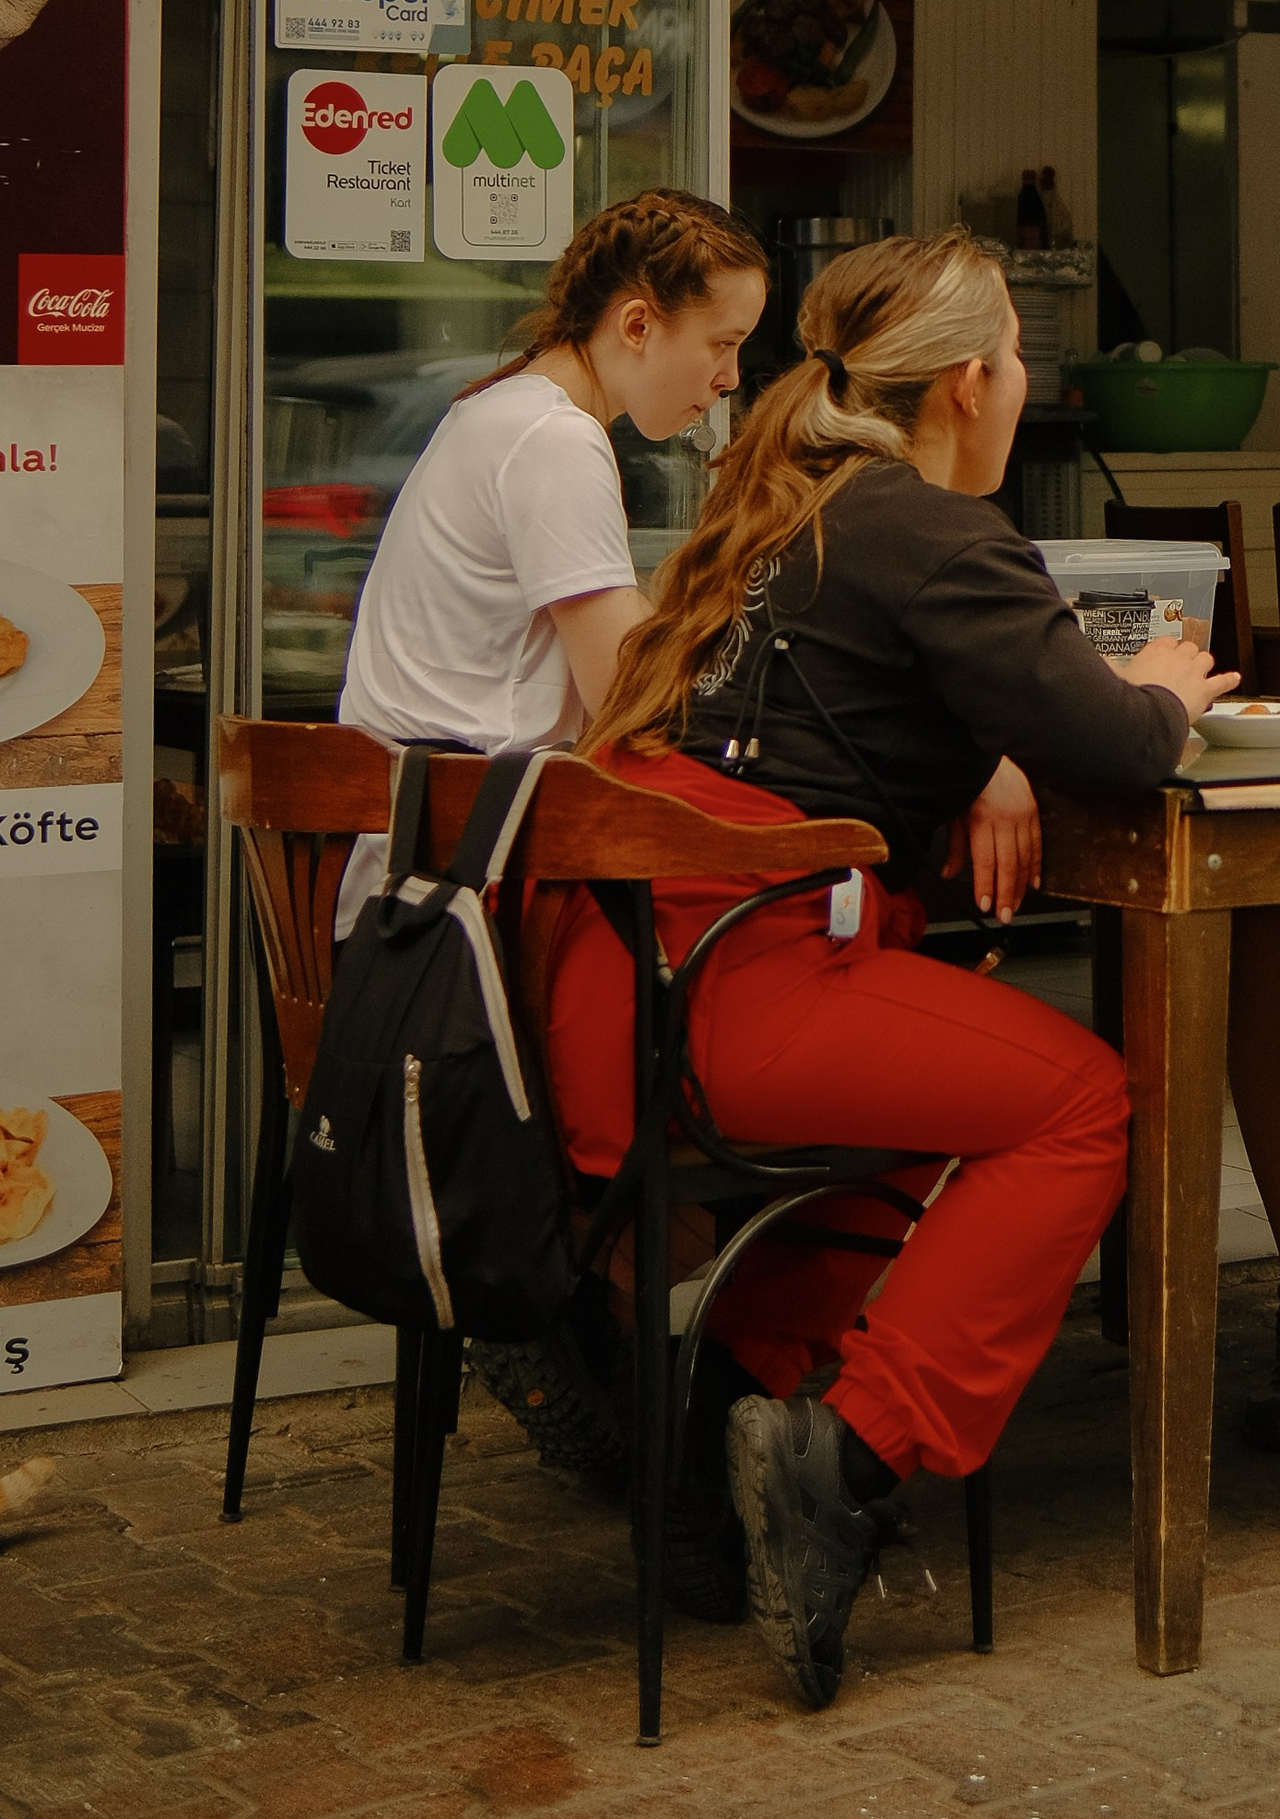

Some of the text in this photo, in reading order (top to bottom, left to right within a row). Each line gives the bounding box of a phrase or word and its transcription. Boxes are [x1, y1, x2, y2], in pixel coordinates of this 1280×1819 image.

[386, 5, 428, 22] Card
[308, 18, 360, 29] 444 92 83
[302, 102, 413, 130] Edenred
[367, 160, 412, 176] Ticket
[327, 174, 412, 191] Restaurant
[473, 173, 536, 188] multinet
[390, 197, 412, 208] Kart
[28, 288, 114, 319] Coca-Cola
[37, 323, 105, 333] Gerçek Mucize
